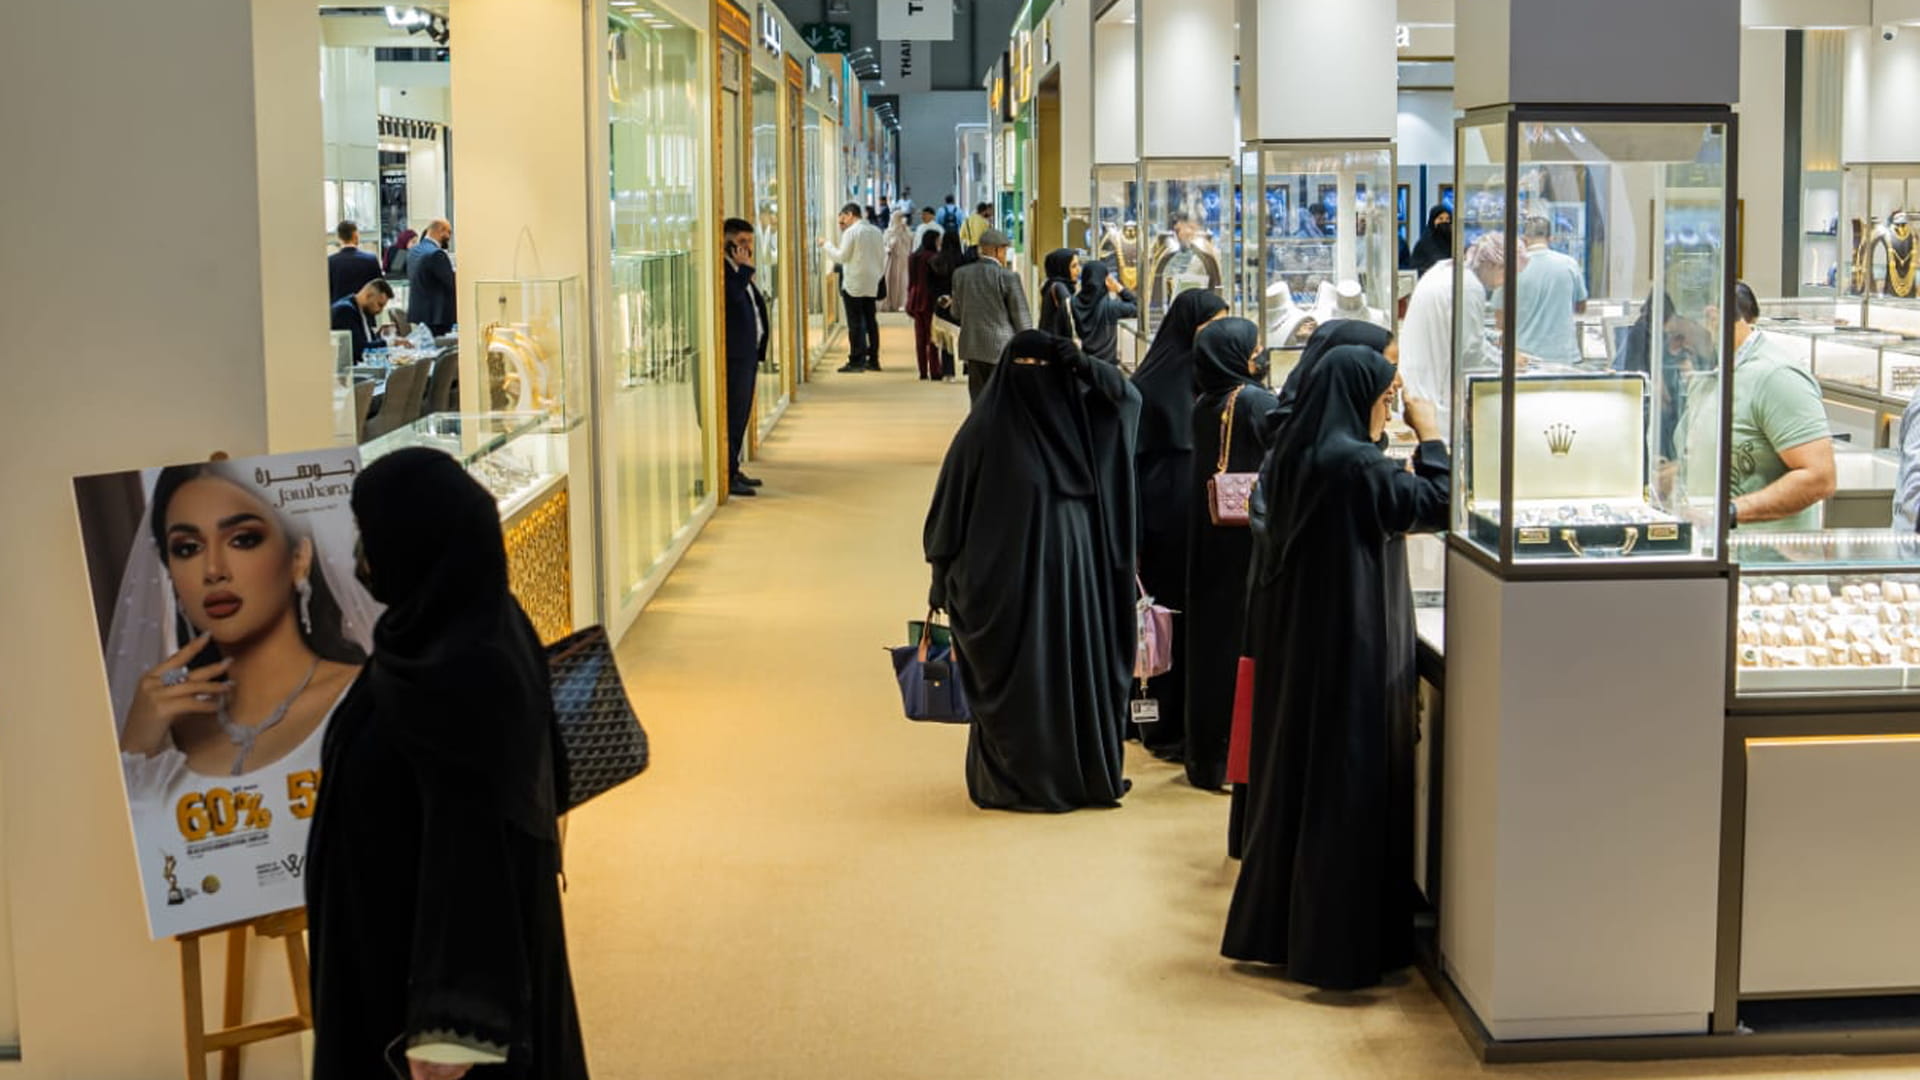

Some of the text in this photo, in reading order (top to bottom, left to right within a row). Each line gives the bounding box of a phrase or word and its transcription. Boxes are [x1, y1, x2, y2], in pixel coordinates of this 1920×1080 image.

[908, 0, 924, 15] T
[900, 40, 912, 78] THAI
[176, 786, 273, 842] 60%
